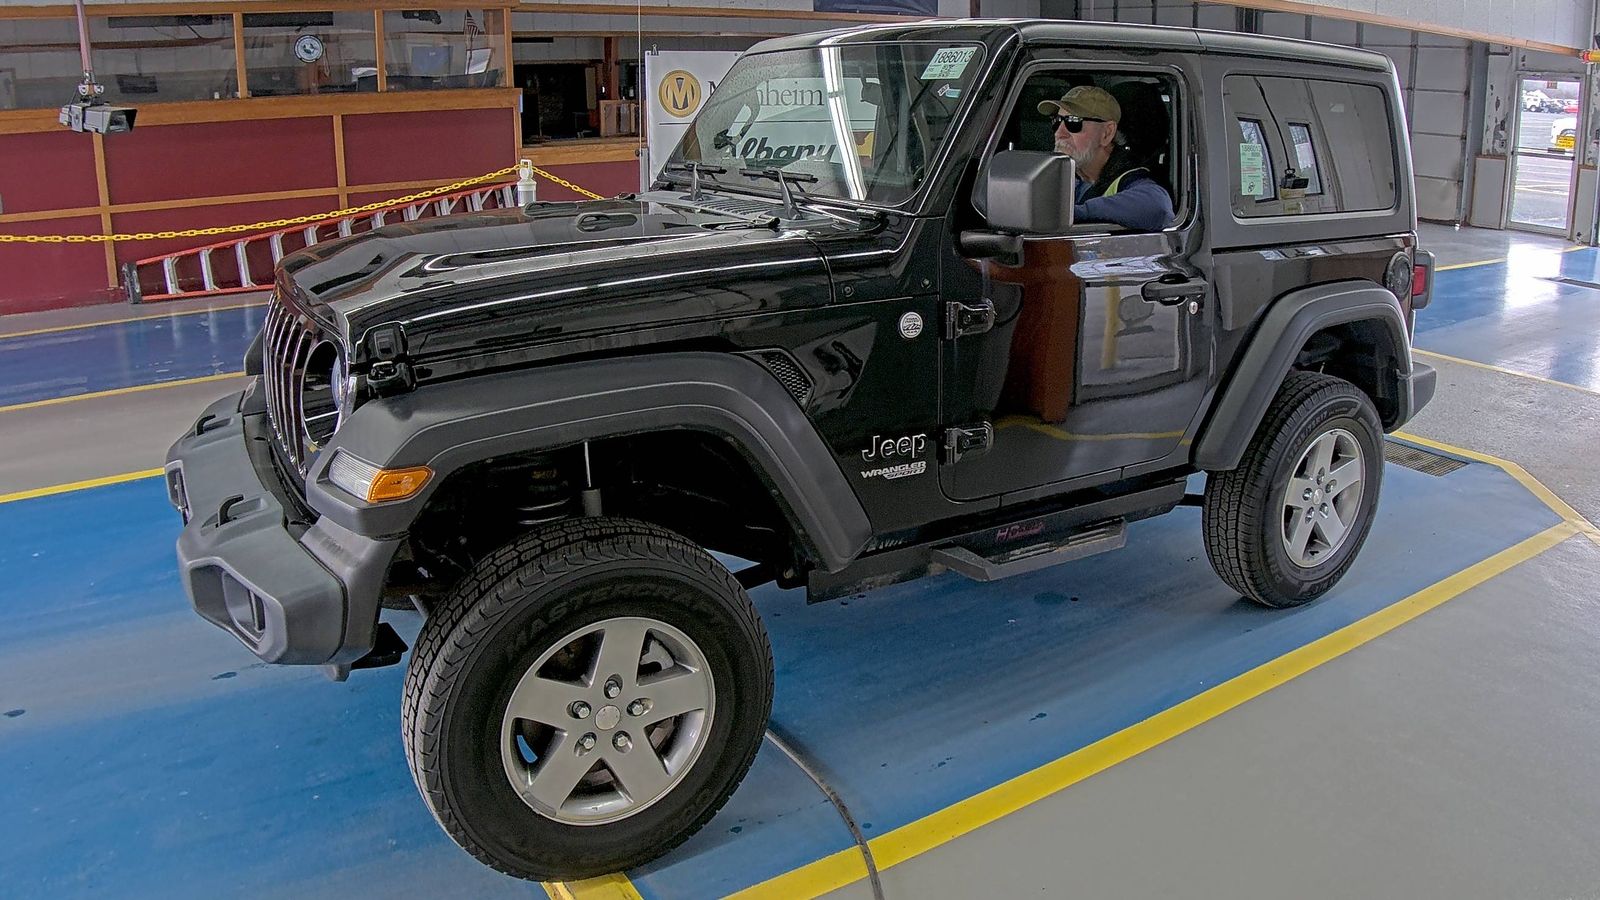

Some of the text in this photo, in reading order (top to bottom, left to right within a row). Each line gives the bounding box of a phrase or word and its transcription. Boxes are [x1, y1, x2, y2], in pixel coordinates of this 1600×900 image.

[730, 137, 837, 162] lbany
[861, 433, 927, 462] Jeep
[860, 460, 927, 478] WRANGLER
